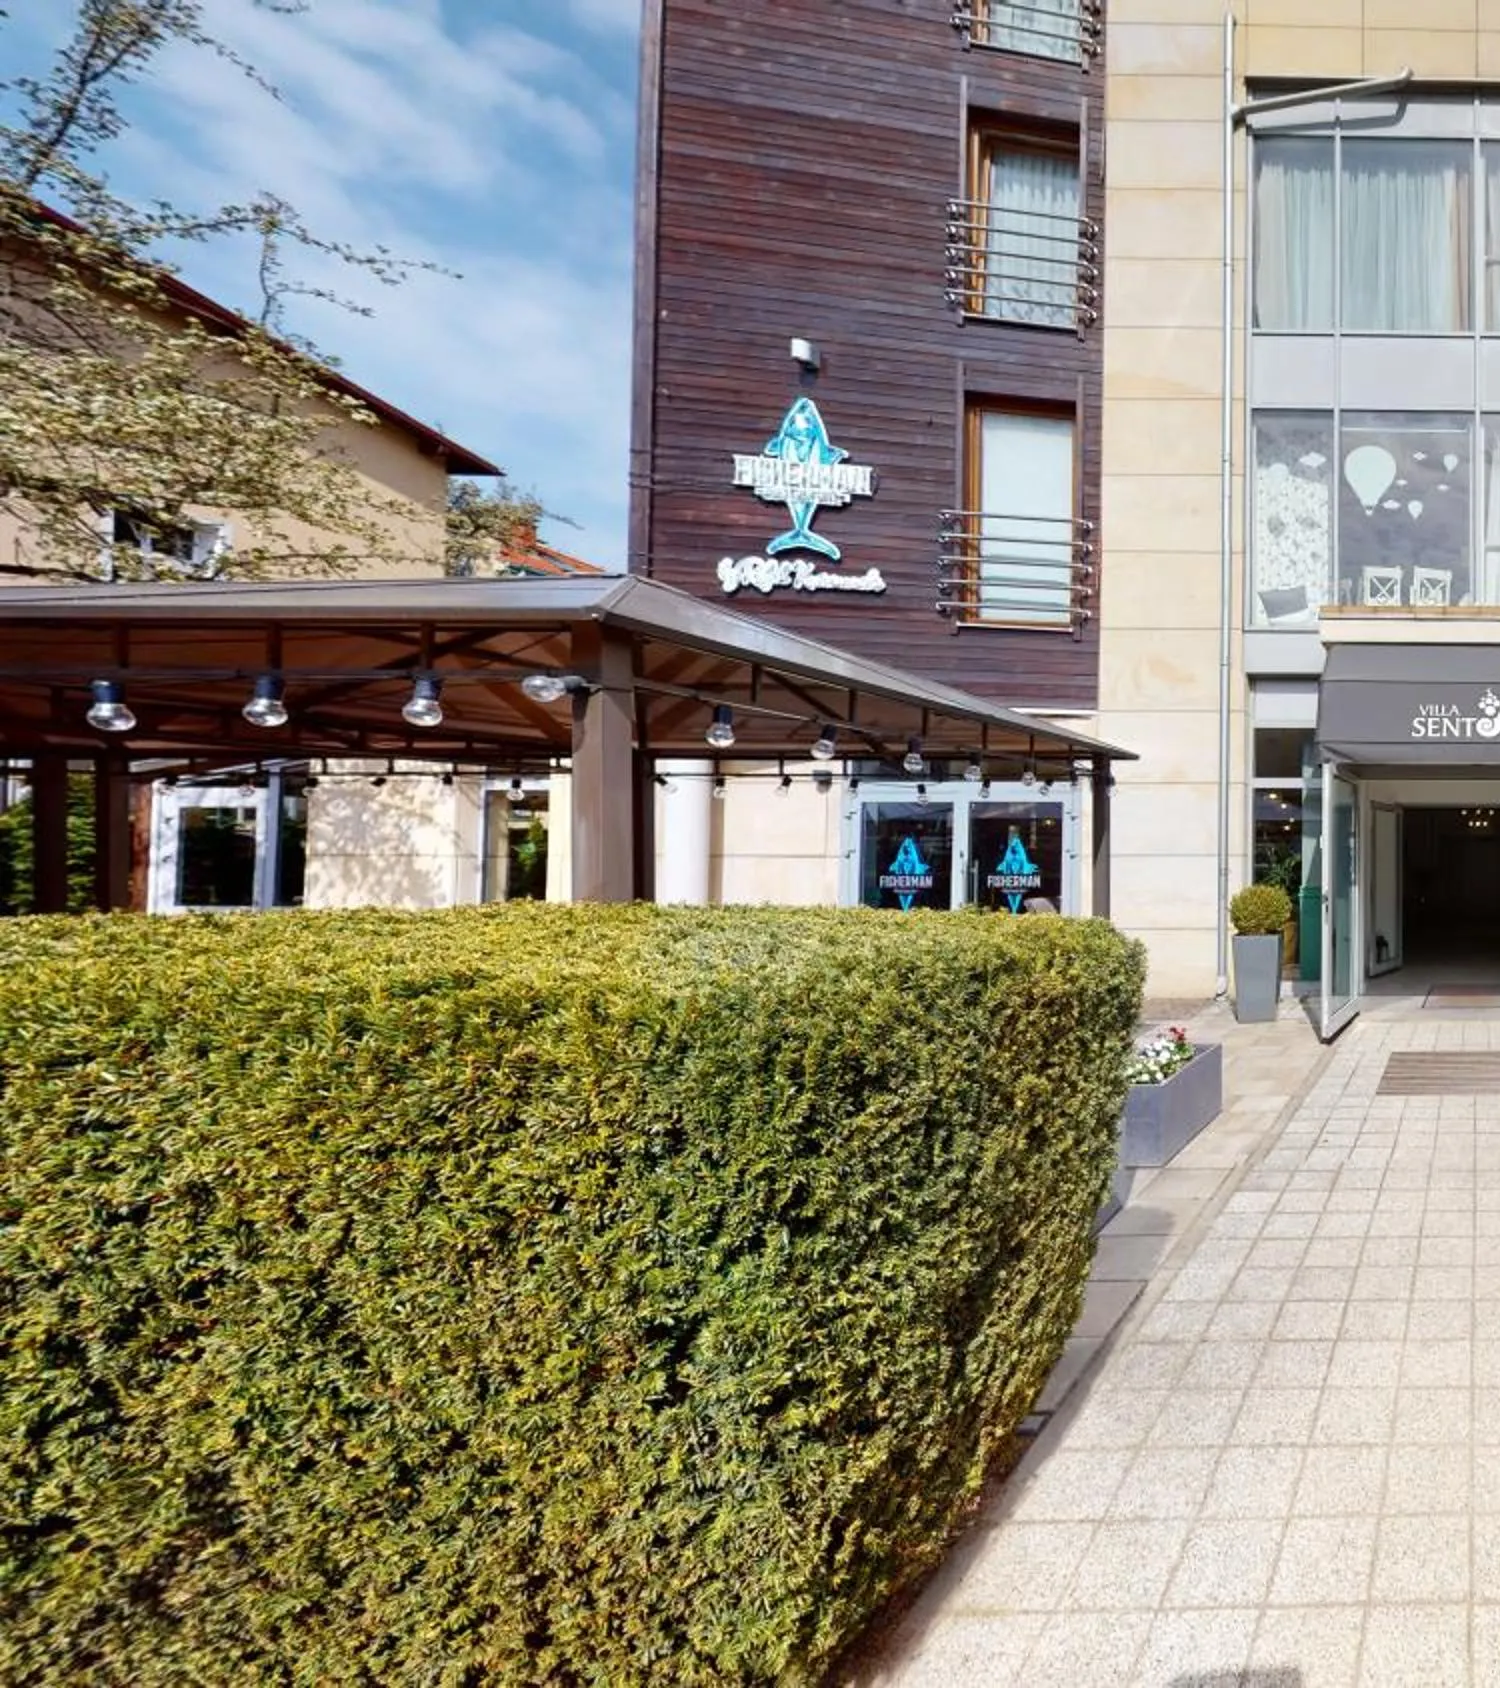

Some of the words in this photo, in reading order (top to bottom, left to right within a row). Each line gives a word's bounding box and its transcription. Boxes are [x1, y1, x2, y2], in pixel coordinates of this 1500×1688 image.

[1419, 703, 1460, 717] VILLA
[879, 875, 933, 888] FISHERMAN
[987, 875, 1041, 889] FISHERMAN
